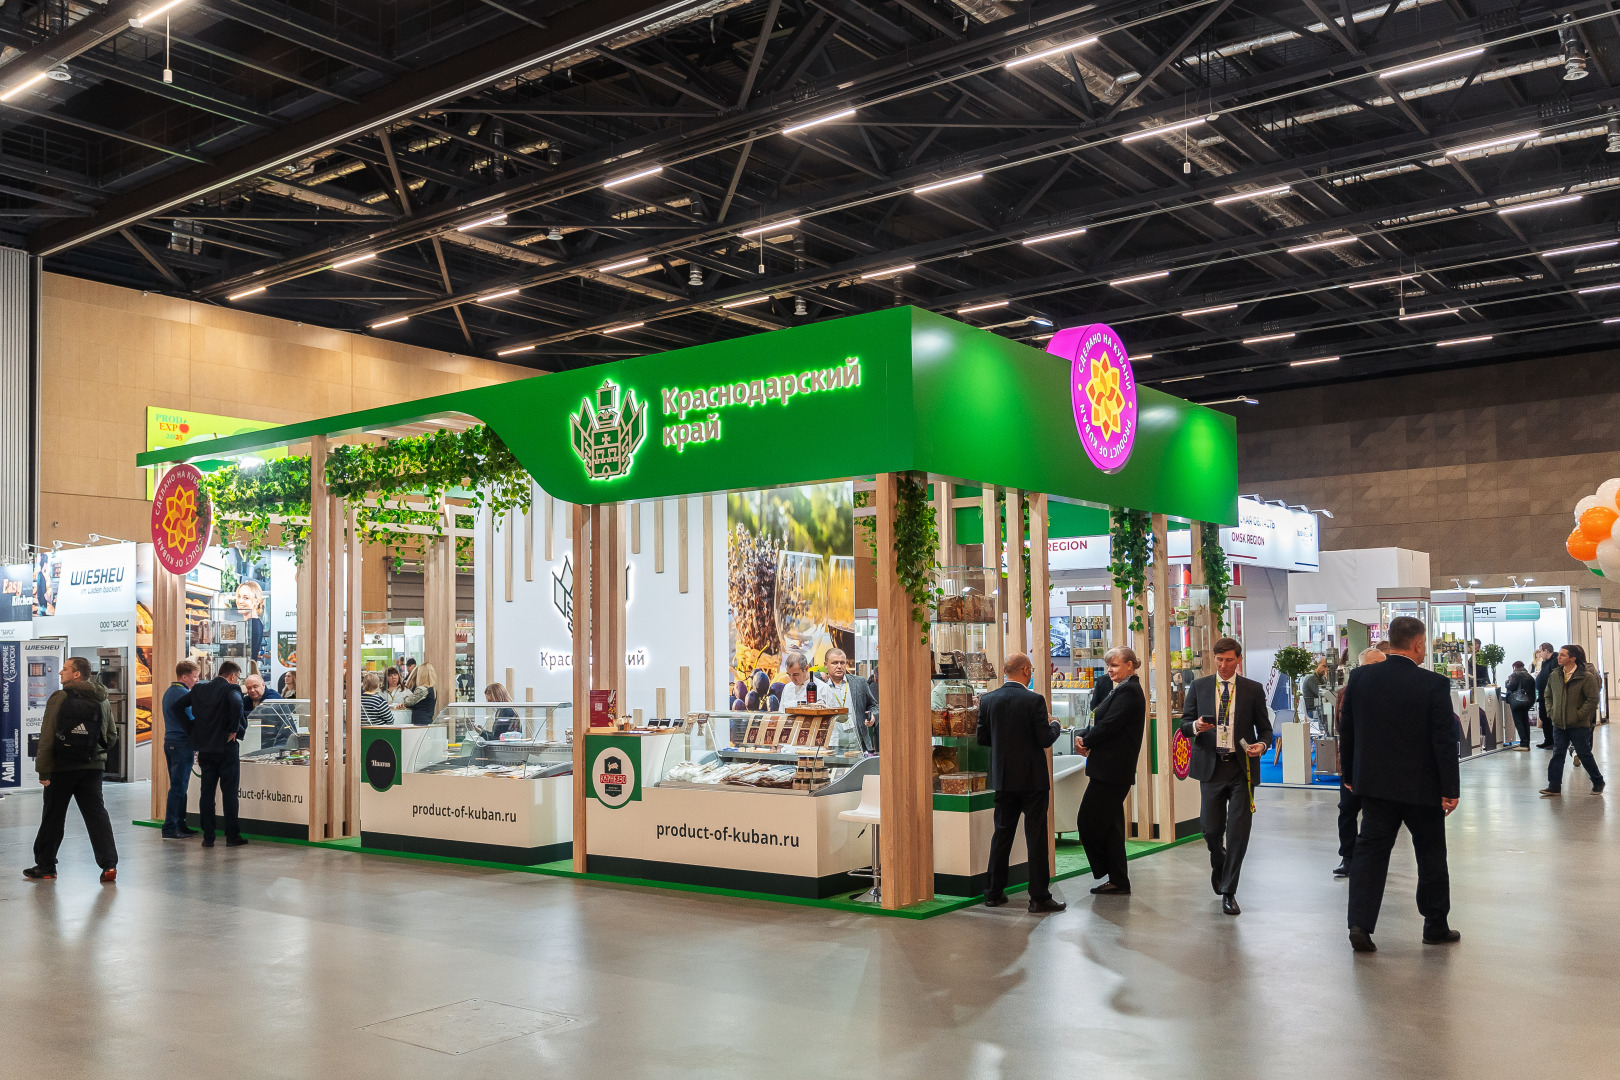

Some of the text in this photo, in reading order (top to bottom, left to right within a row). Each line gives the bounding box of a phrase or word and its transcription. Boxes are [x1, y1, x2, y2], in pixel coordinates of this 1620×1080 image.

[1078, 332, 1132, 390] СДЕЛАНО НА КУБАНИ
[661, 356, 861, 419] Краснодарский
[155, 413, 183, 423] PROD
[165, 433, 183, 442] 2025
[662, 413, 720, 452] край
[1079, 404, 1132, 459] PRODUCT OF KUBAN
[155, 474, 176, 516] СДЕЛАНО
[176, 470, 186, 479] НА
[1048, 540, 1088, 552] REGION
[1231, 532, 1265, 546] OMSK REGION
[156, 536, 174, 565] KUBAN
[175, 559, 184, 568] OF
[70, 566, 125, 586] WIESHEU
[2, 578, 22, 596] Easy
[88, 586, 102, 594] Laden
[12, 594, 34, 606] Kitchen
[237, 788, 303, 804] duct-of-kuban.ru
[412, 803, 517, 823] product-of-kuban.ru
[656, 822, 800, 849] product-of-kuban.ru
